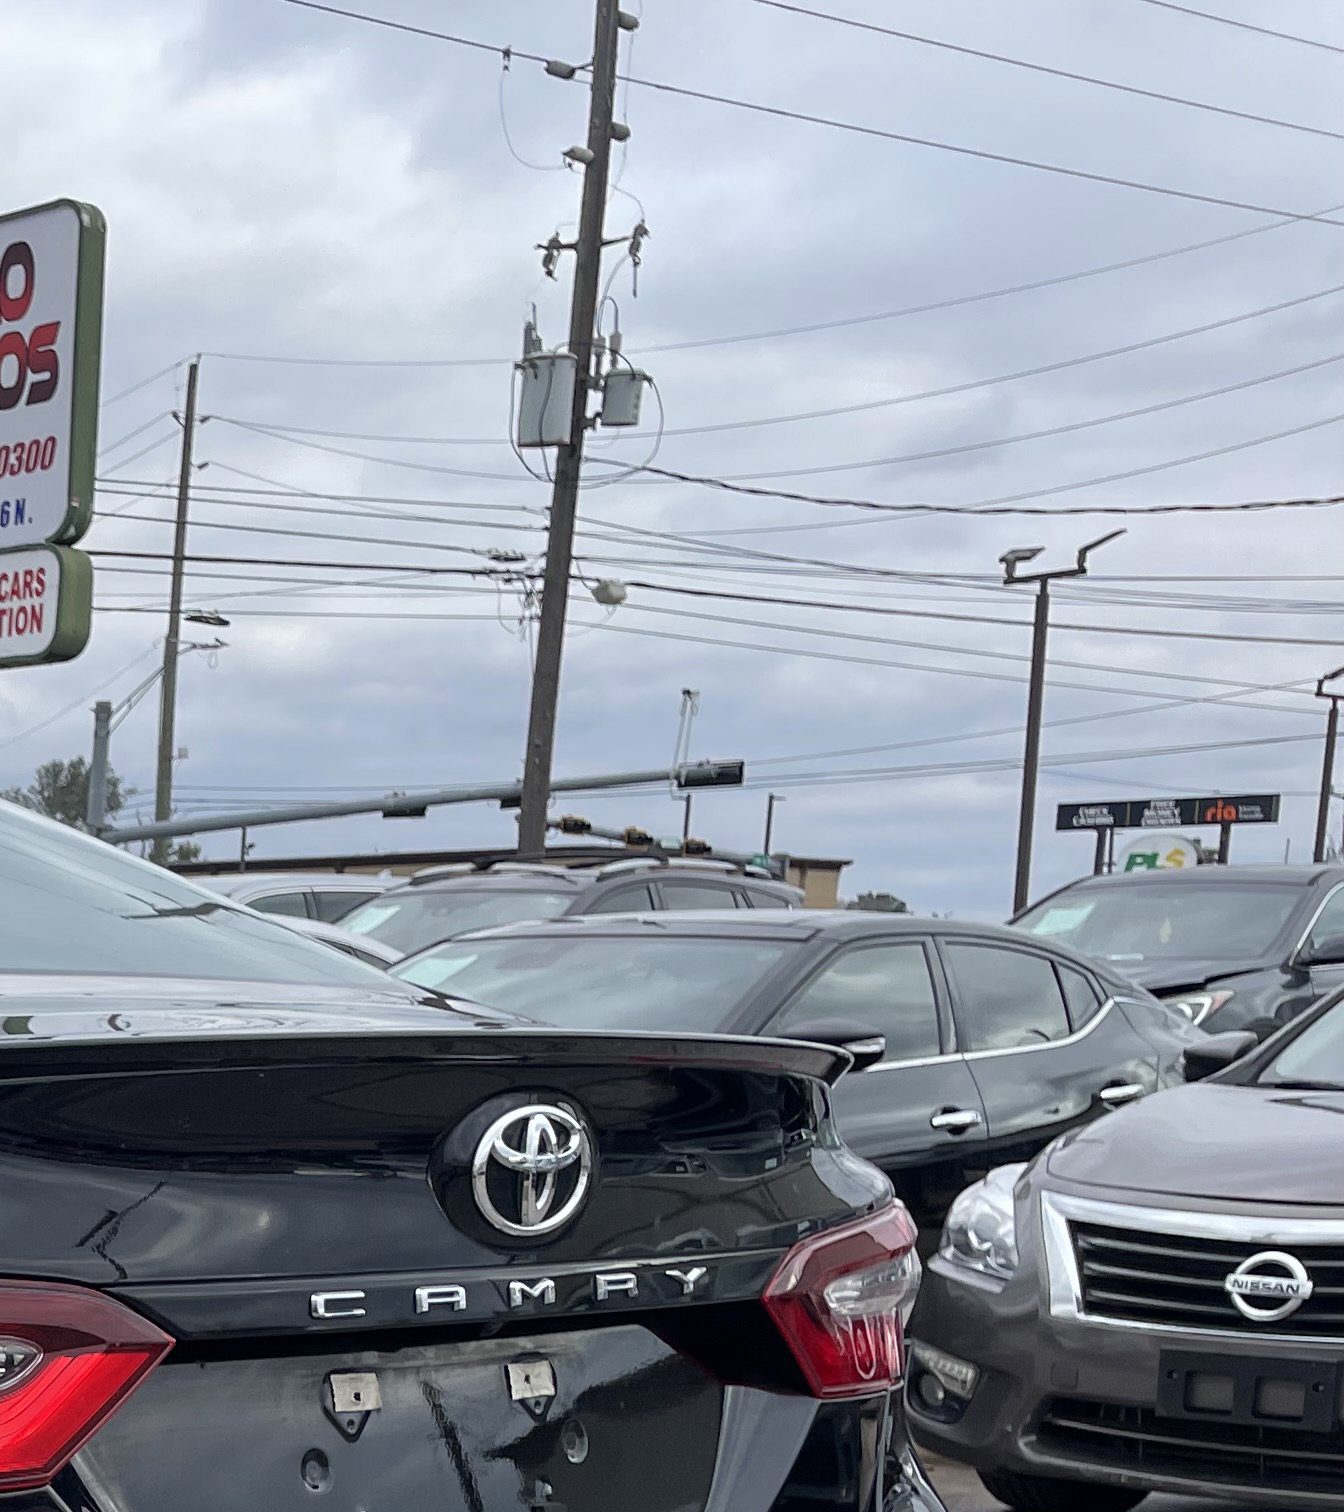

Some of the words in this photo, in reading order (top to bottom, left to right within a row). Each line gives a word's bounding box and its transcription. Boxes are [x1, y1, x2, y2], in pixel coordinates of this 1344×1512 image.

[1, 501, 11, 527] 6
[311, 1266, 706, 1319] CAMRY
[1232, 1278, 1300, 1295] NISSAN
